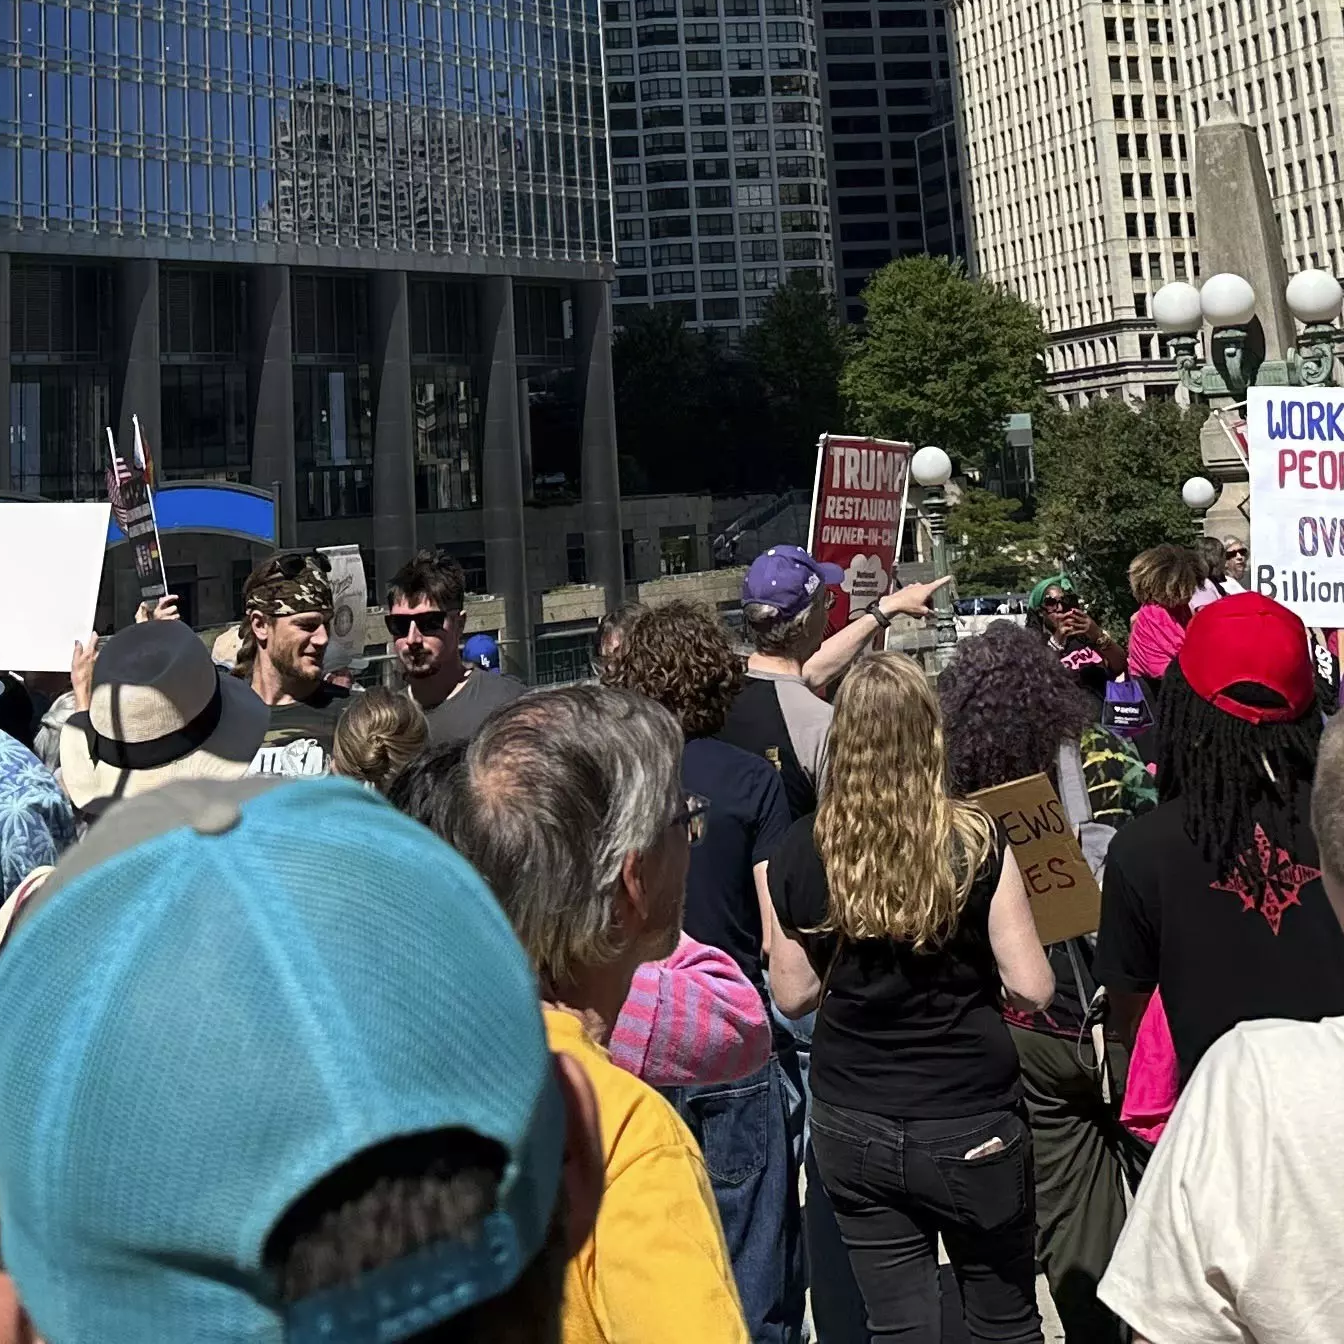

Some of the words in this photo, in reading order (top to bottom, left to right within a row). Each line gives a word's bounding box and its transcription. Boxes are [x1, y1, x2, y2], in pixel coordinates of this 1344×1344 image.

[830, 446, 907, 493] TRUMP
[824, 495, 900, 522] RESTAURAN
[998, 799, 1065, 846] EWS
